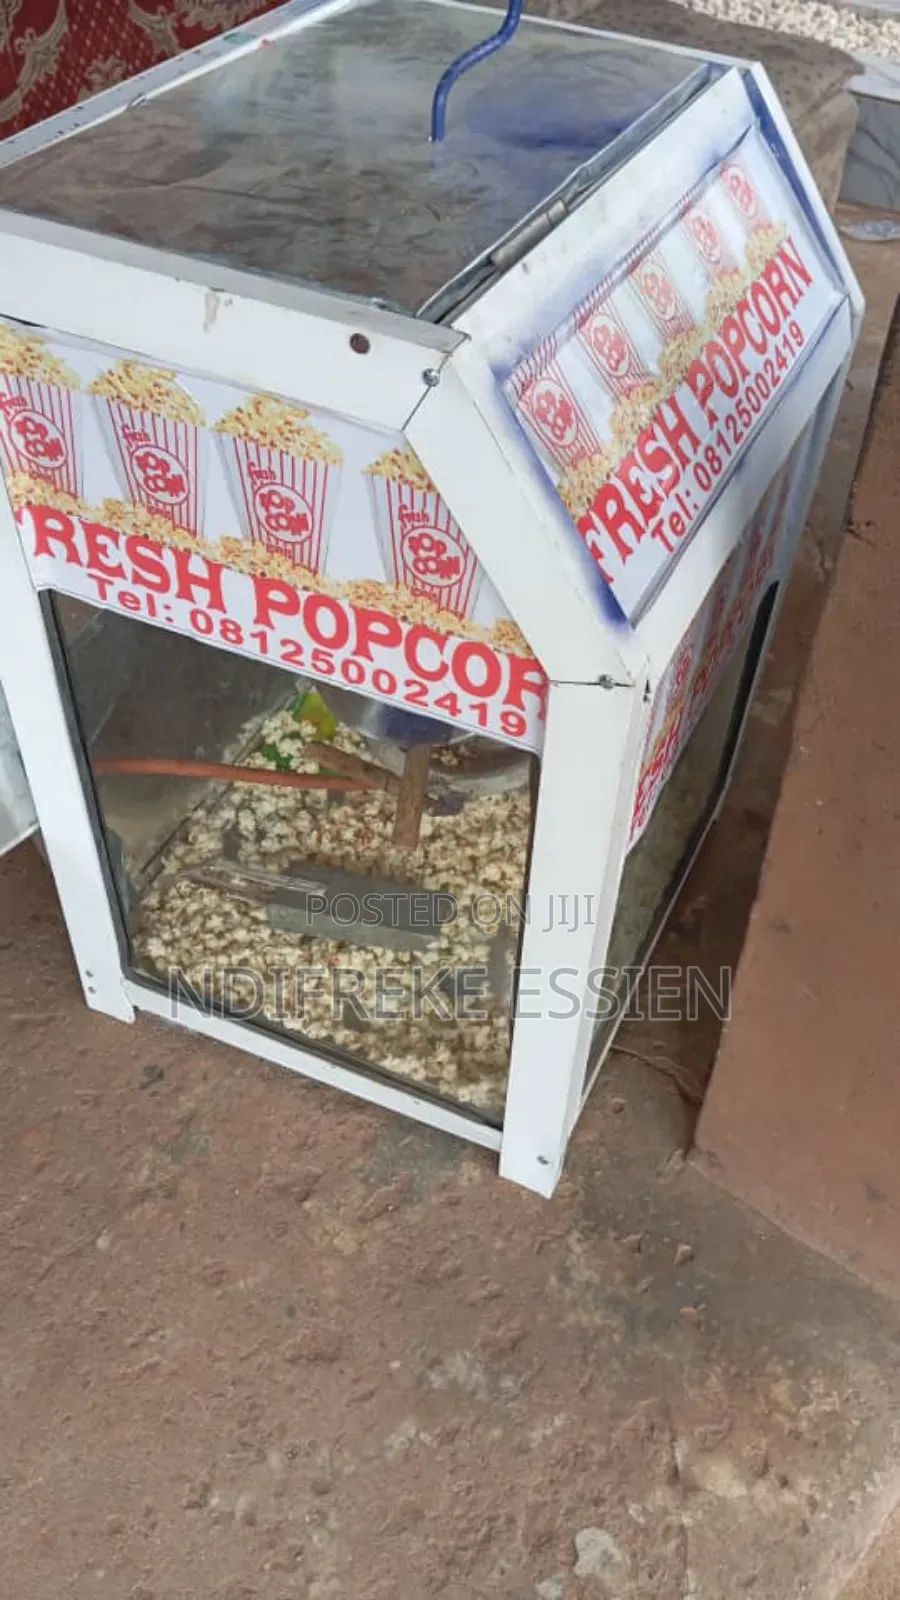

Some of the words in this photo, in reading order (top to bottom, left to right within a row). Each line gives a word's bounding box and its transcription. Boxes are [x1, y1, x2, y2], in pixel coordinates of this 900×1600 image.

[577, 393, 701, 584] FRESH
[684, 236, 813, 430] POPCORN
[651, 488, 699, 553] Tel:
[693, 320, 805, 492] 08125002419
[17, 504, 230, 614] RESH
[251, 574, 549, 722] POPCOR
[87, 572, 174, 623] Tel:
[189, 608, 528, 738] 08125002419
